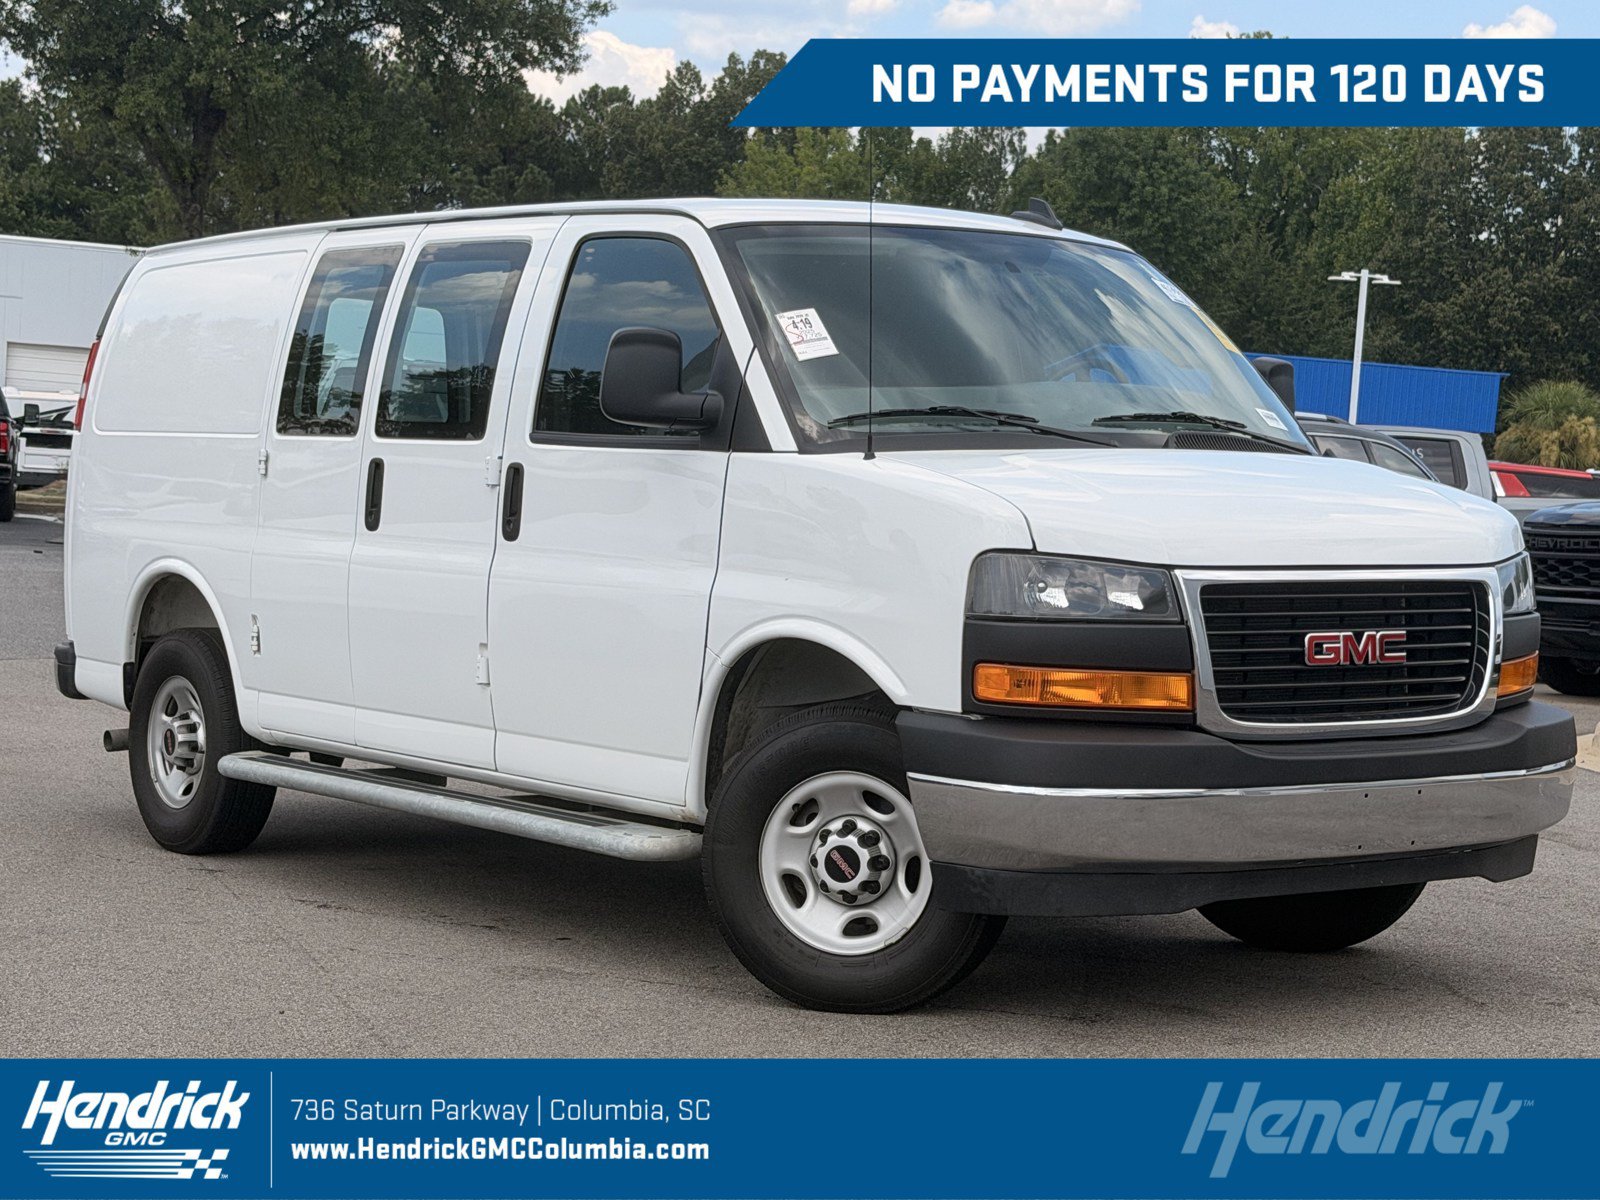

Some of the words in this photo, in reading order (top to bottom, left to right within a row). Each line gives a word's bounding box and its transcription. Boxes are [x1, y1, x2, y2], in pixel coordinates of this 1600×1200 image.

[1525, 536, 1600, 549] HEVROL
[1304, 630, 1407, 666] GMC
[830, 849, 856, 880] GMC
